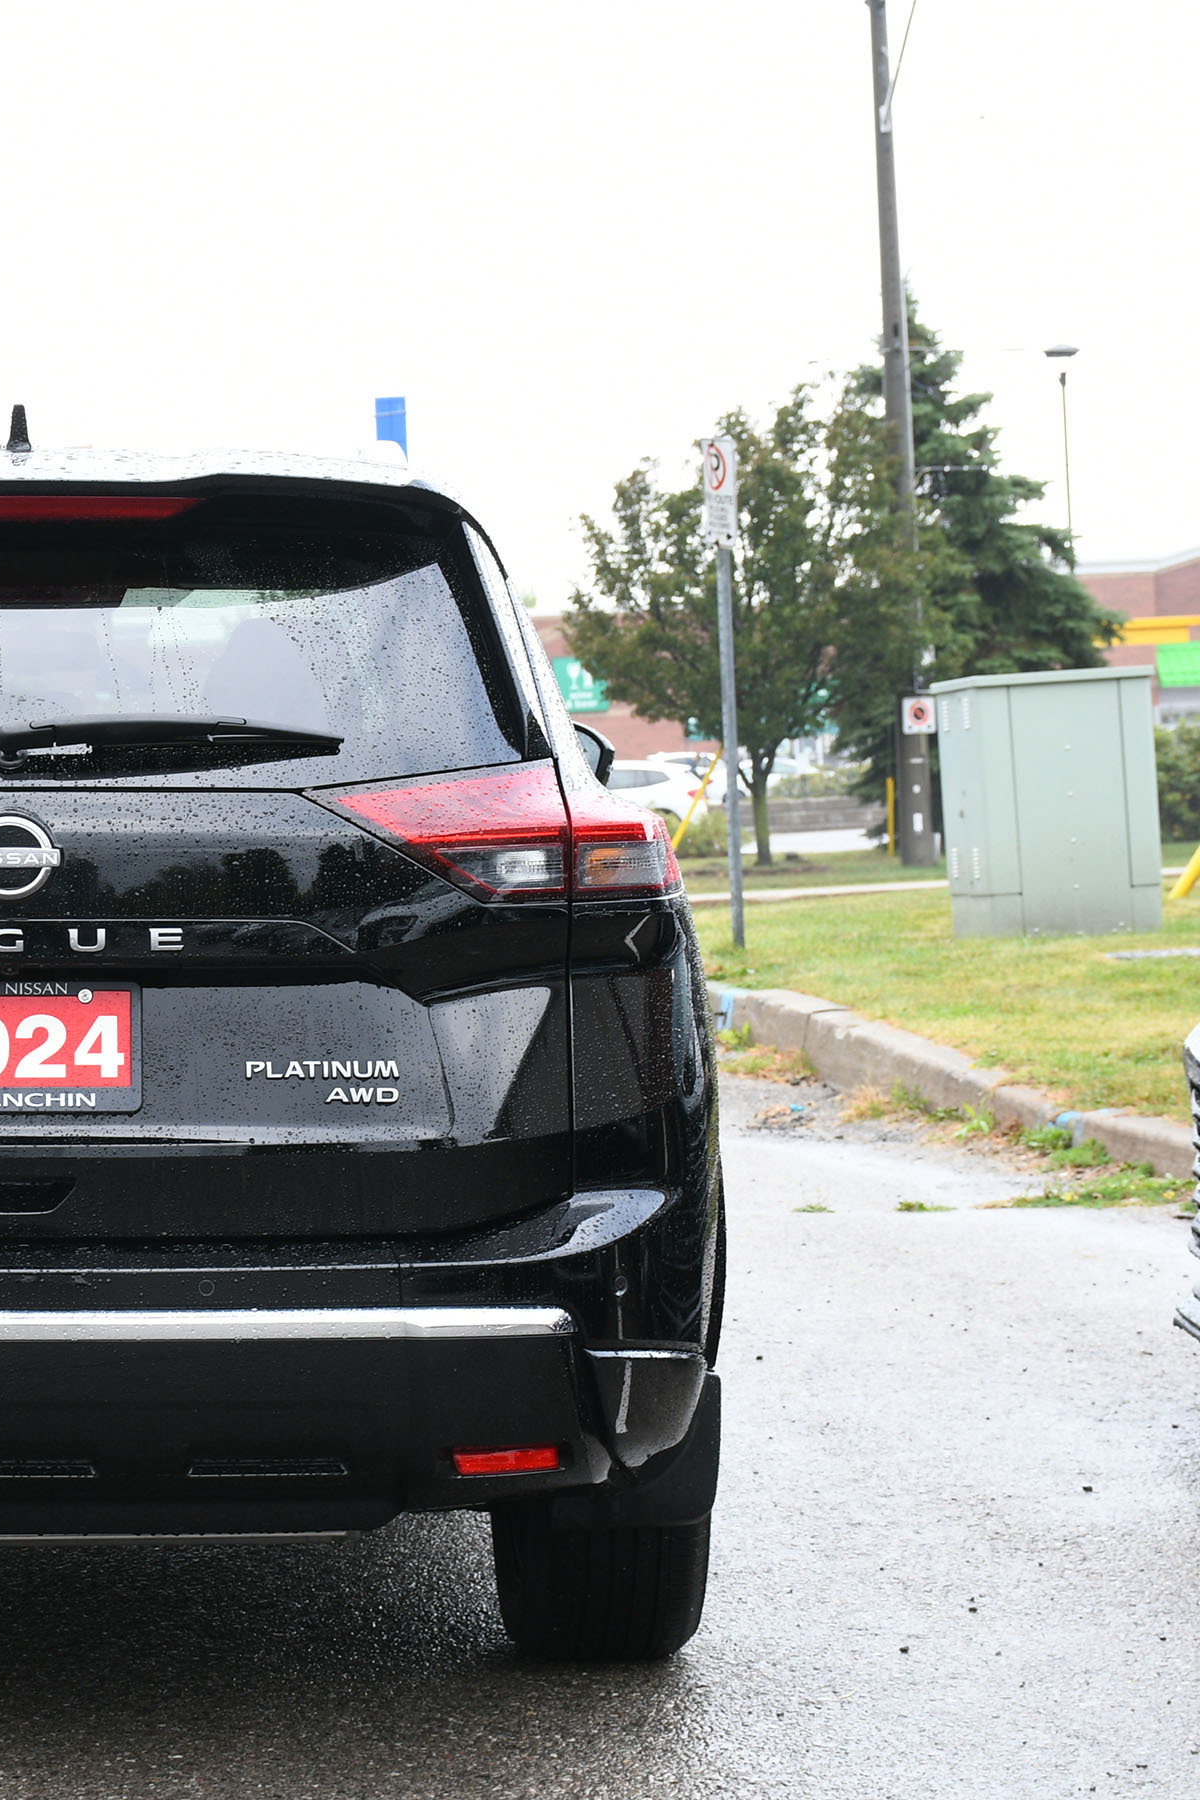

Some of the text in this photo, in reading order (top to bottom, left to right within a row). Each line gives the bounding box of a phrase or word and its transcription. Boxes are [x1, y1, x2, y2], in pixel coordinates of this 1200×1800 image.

[4, 982, 69, 996] NISSAN
[245, 1060, 400, 1079] PLATINUM
[324, 1087, 400, 1104] AWD
